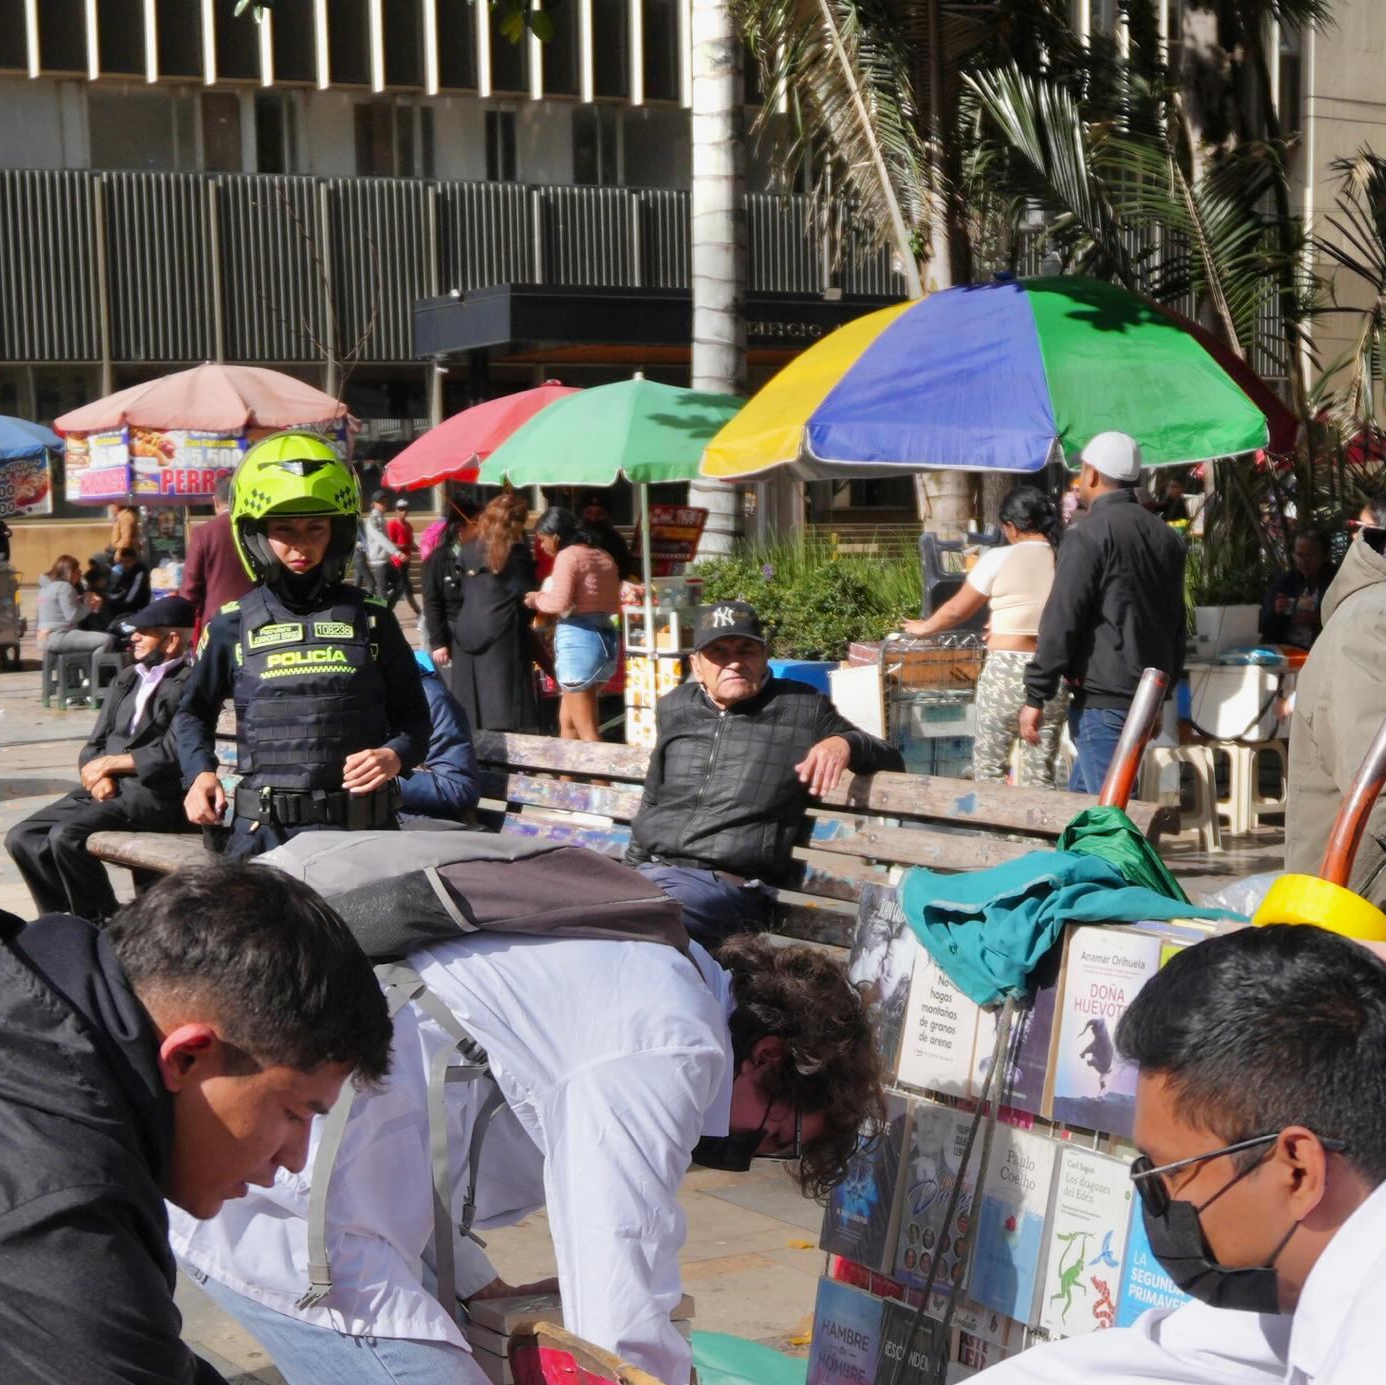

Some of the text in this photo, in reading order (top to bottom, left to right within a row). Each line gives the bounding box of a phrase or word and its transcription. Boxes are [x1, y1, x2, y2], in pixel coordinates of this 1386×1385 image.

[748, 321, 821, 336] DIFICIO
[161, 468, 230, 494] PERR
[267, 646, 347, 668] POLICÍA
[1081, 951, 1146, 970] Anamar Orihuela
[930, 984, 953, 1004] hagas
[1090, 983, 1125, 1002] DOÑA
[921, 1003, 957, 1021] montañas
[919, 1015, 956, 1036] de granos
[919, 1030, 953, 1049] de arena
[1006, 1149, 1036, 1172] Paulo
[1000, 1166, 1036, 1191] Coelho
[1065, 1172, 1111, 1195] Los dragones
[1063, 1185, 1094, 1203] del Edén
[1133, 1250, 1147, 1265] LA
[822, 1320, 870, 1352] HAMBRE
[819, 1351, 866, 1384] HOMBRE
